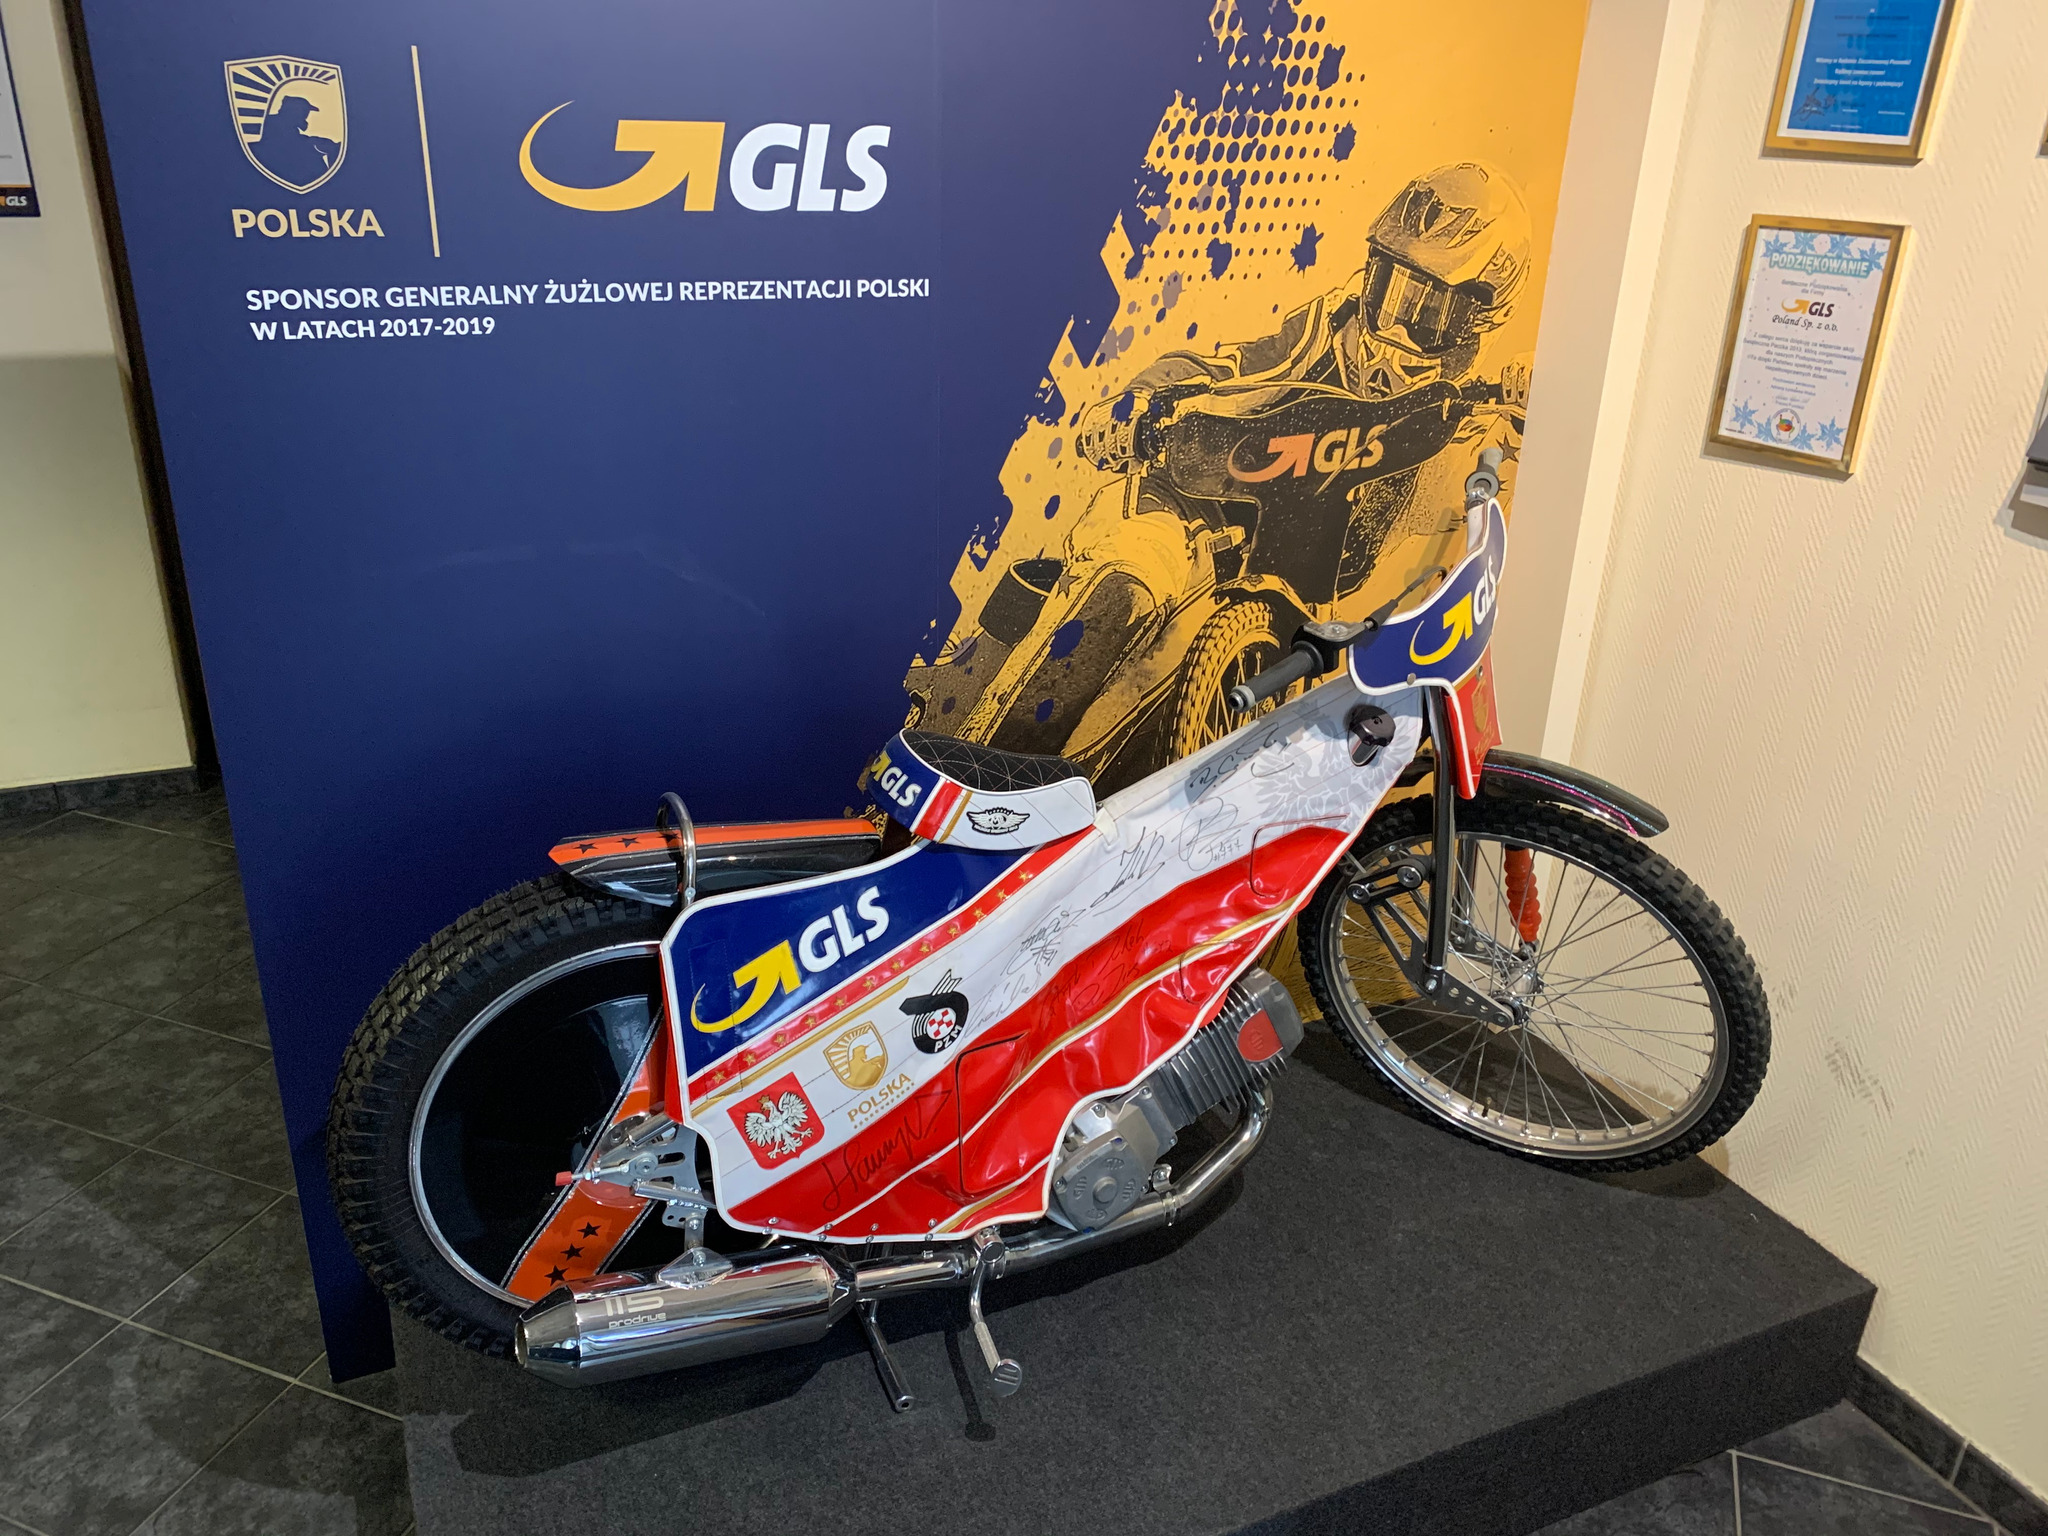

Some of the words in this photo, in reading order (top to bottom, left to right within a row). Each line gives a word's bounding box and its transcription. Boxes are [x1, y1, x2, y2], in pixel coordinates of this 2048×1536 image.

[728, 122, 891, 212] GLS
[6, 196, 27, 206] GLS
[231, 208, 385, 239] POLSKA
[1771, 253, 1869, 276] PODZIĘKOWANIE
[246, 286, 379, 311] SPONSOR
[385, 284, 539, 309] GENERALNY
[544, 278, 673, 307] ŻUŻLOWEJ
[679, 279, 852, 304] REPREZENTACJI
[857, 278, 930, 299] POLSKI
[1808, 301, 1835, 317] GLS
[250, 321, 277, 341] W
[283, 320, 375, 340] LATACH
[380, 316, 495, 338] 2017-2019
[1772, 314, 1802, 326] Poland
[1801, 318, 1813, 330] Sp.
[1314, 424, 1387, 473] GLS
[881, 766, 922, 807] GLS
[798, 886, 889, 973] GLS
[934, 1025, 962, 1052] PZM
[847, 1073, 911, 1122] POLSKA
